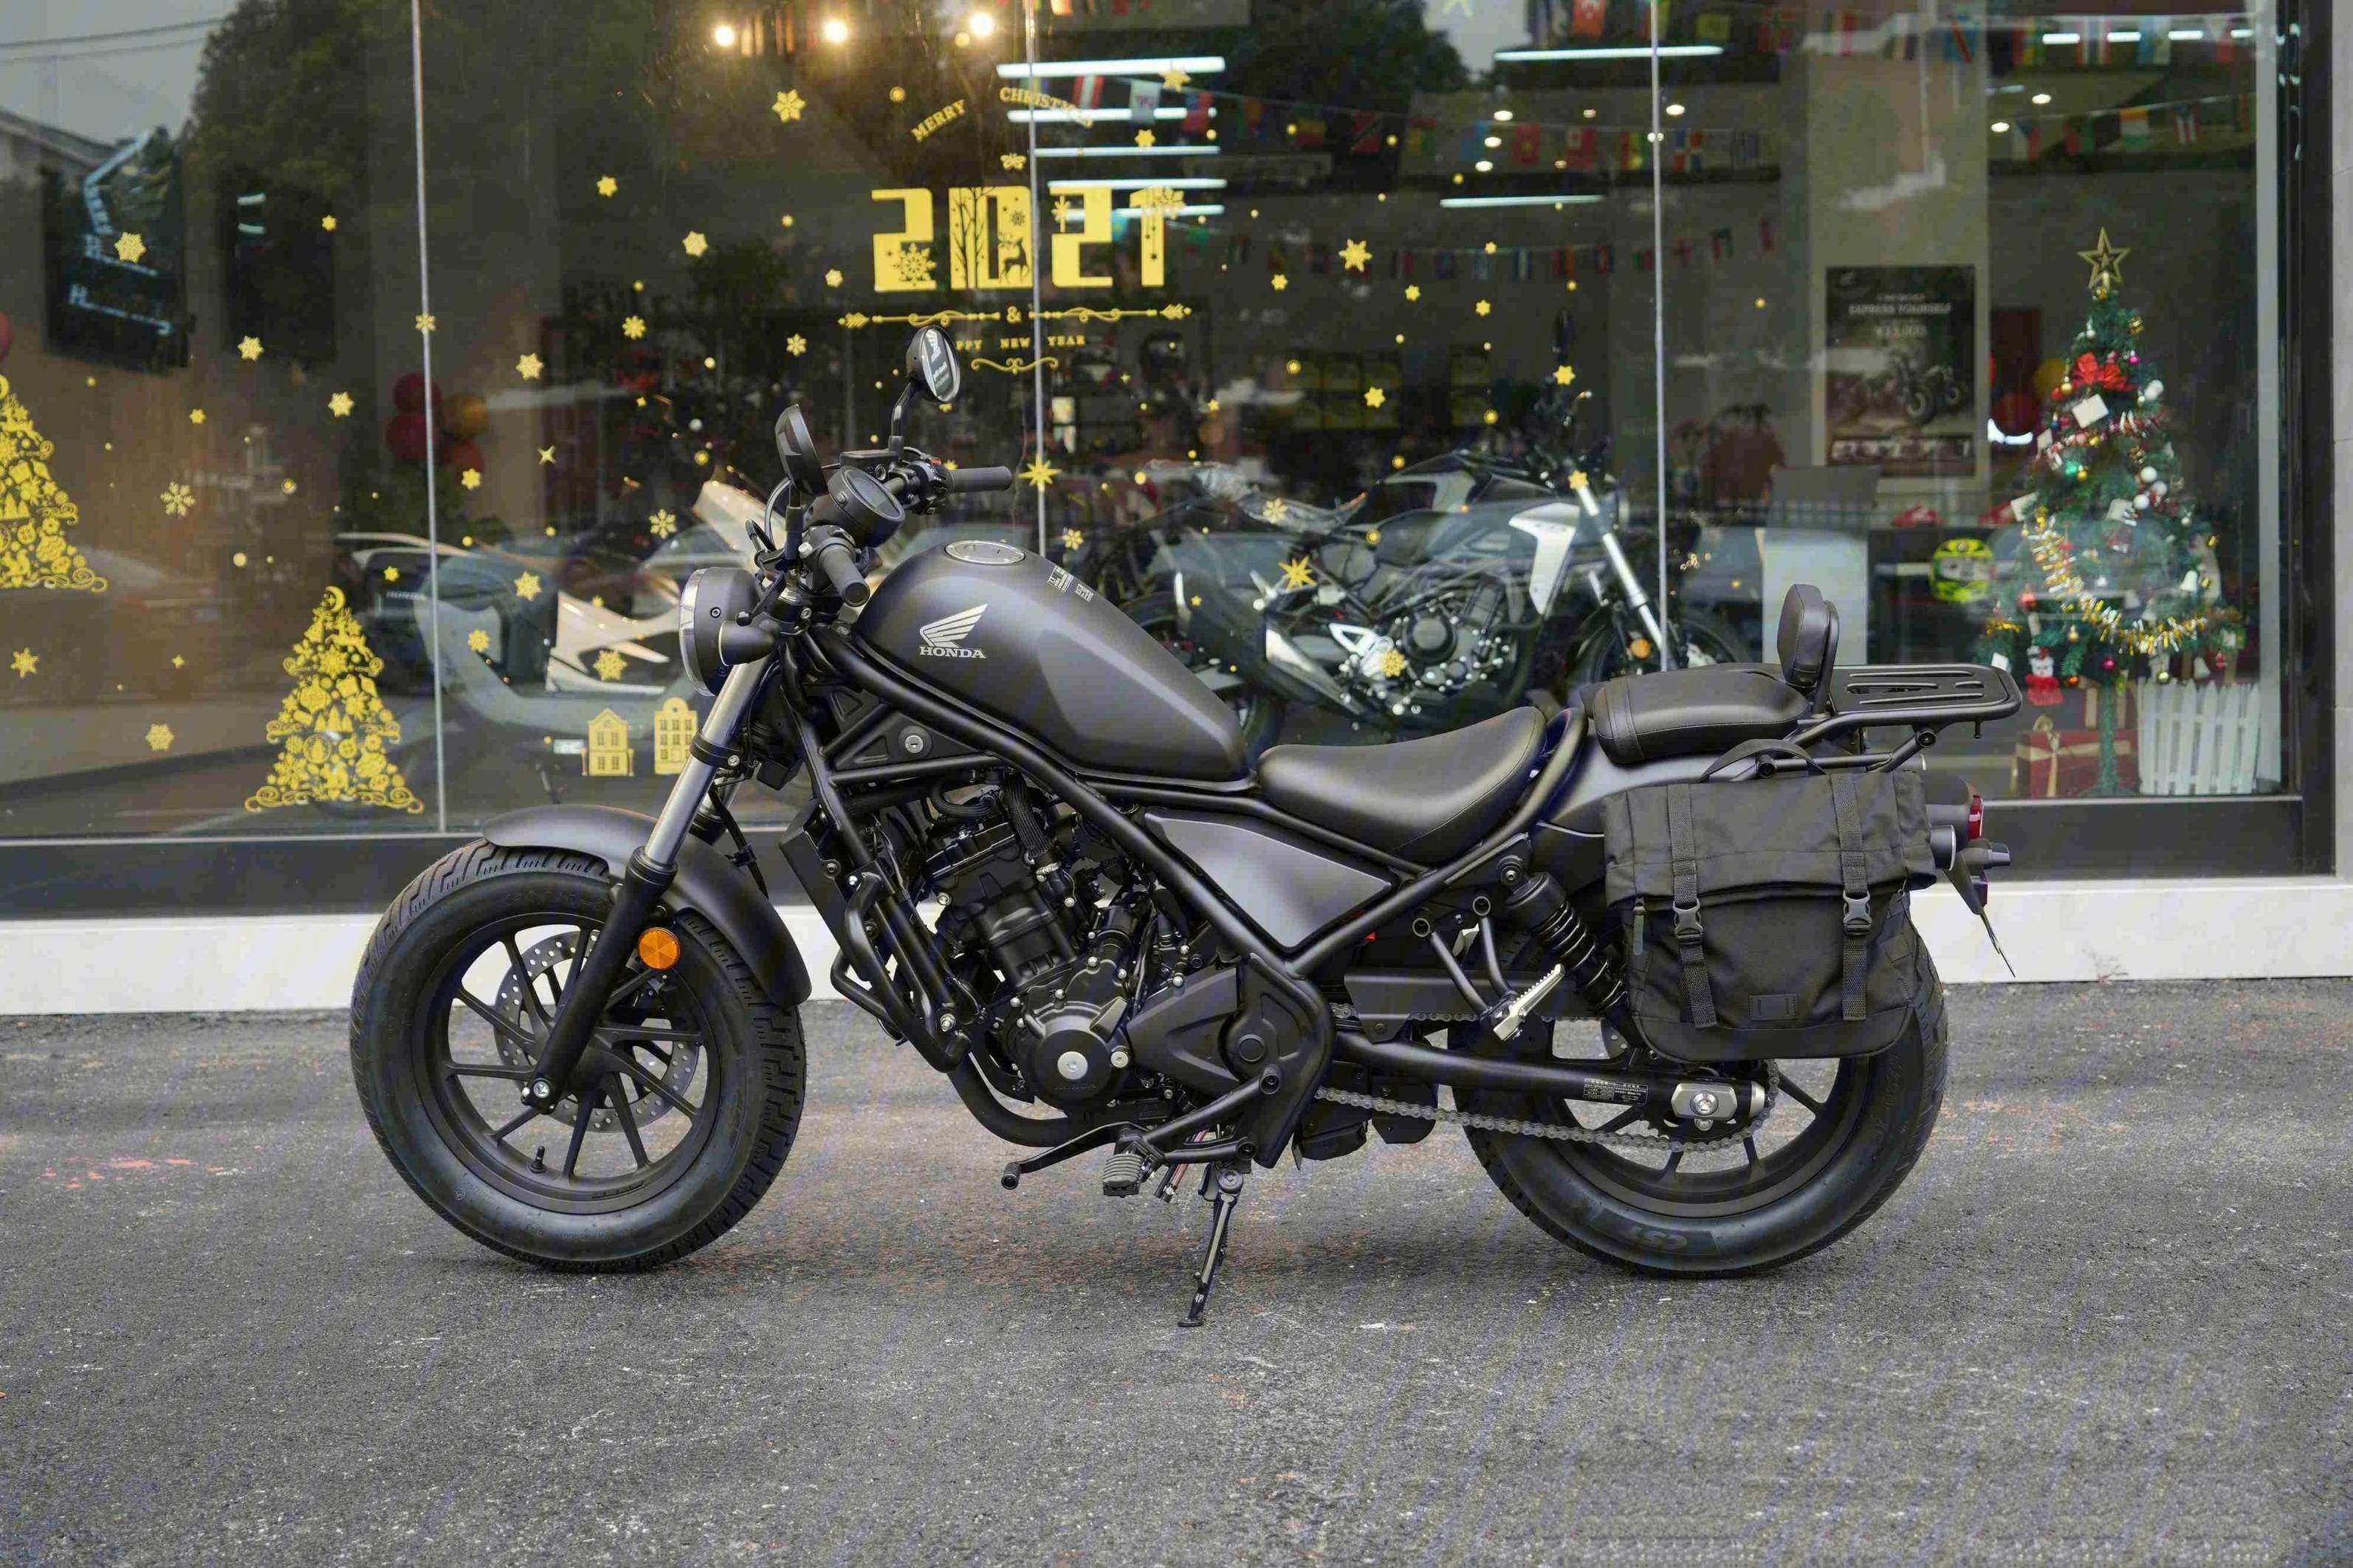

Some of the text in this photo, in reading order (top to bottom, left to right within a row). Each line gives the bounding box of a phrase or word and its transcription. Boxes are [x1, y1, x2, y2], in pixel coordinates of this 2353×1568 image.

[910, 99, 966, 142] MERRY
[871, 185, 1185, 292] 2021
[1006, 306, 1022, 323] &
[955, 334, 1086, 351] PPY NEW YEAR
[919, 646, 987, 659] HONDA
